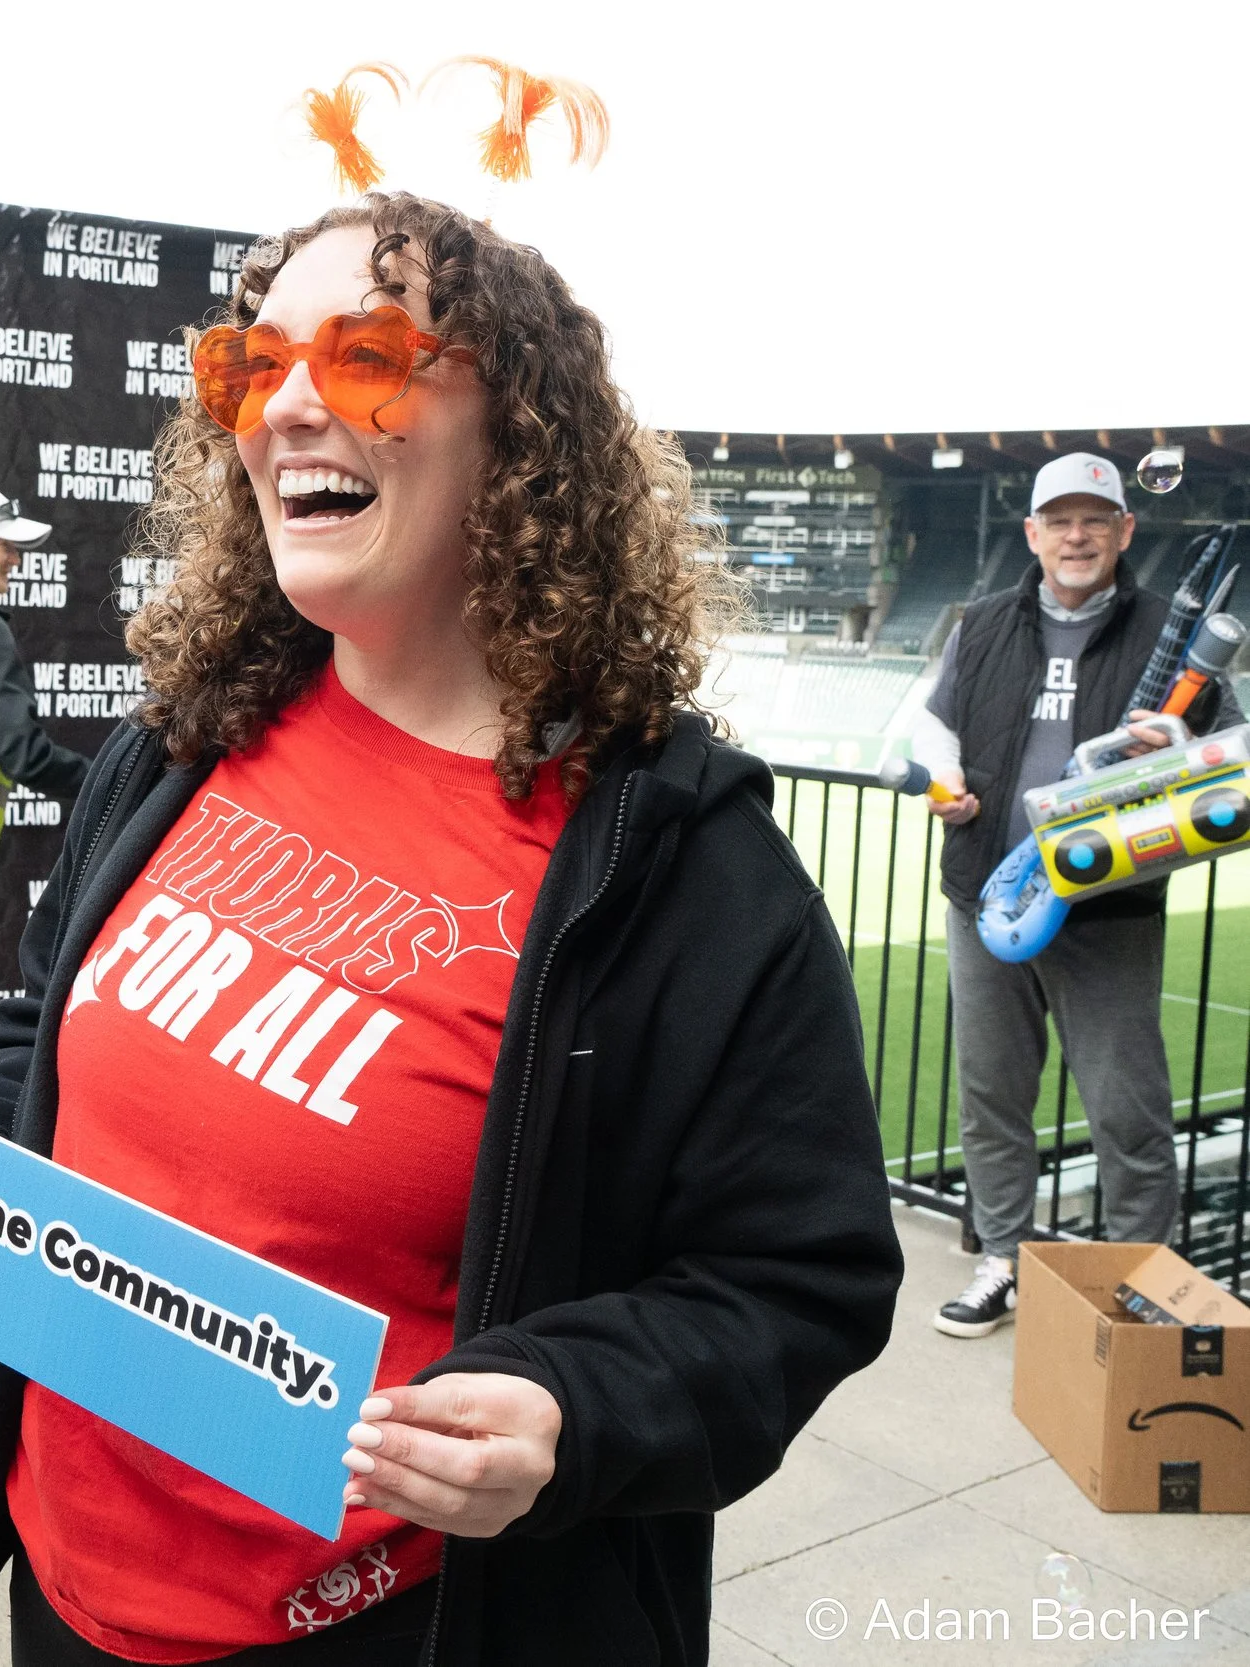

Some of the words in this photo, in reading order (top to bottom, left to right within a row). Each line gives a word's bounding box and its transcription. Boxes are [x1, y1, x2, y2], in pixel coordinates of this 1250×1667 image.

[46, 222, 78, 251] WE
[80, 225, 163, 262] BELIEVE
[213, 241, 244, 270] WE
[43, 251, 63, 277] IN
[67, 254, 160, 288] PORTLAND
[210, 270, 229, 296] IN
[126, 340, 159, 369] WE
[125, 369, 145, 395] IN
[38, 442, 72, 472] WE
[74, 444, 154, 478] BELIEVE
[37, 472, 57, 498] IN
[61, 474, 154, 504] PORTLAND
[755, 468, 796, 484] First
[817, 469, 857, 485] Tech
[121, 557, 153, 586] WE
[119, 586, 139, 612] IN
[33, 662, 66, 691] WE
[69, 663, 147, 692] BELIEVE
[1031, 692, 1075, 720] RT
[145, 792, 458, 995] THORNS
[96, 893, 253, 1042] FOR
[209, 965, 403, 1126] ALL
[44, 1226, 333, 1403] Community.
